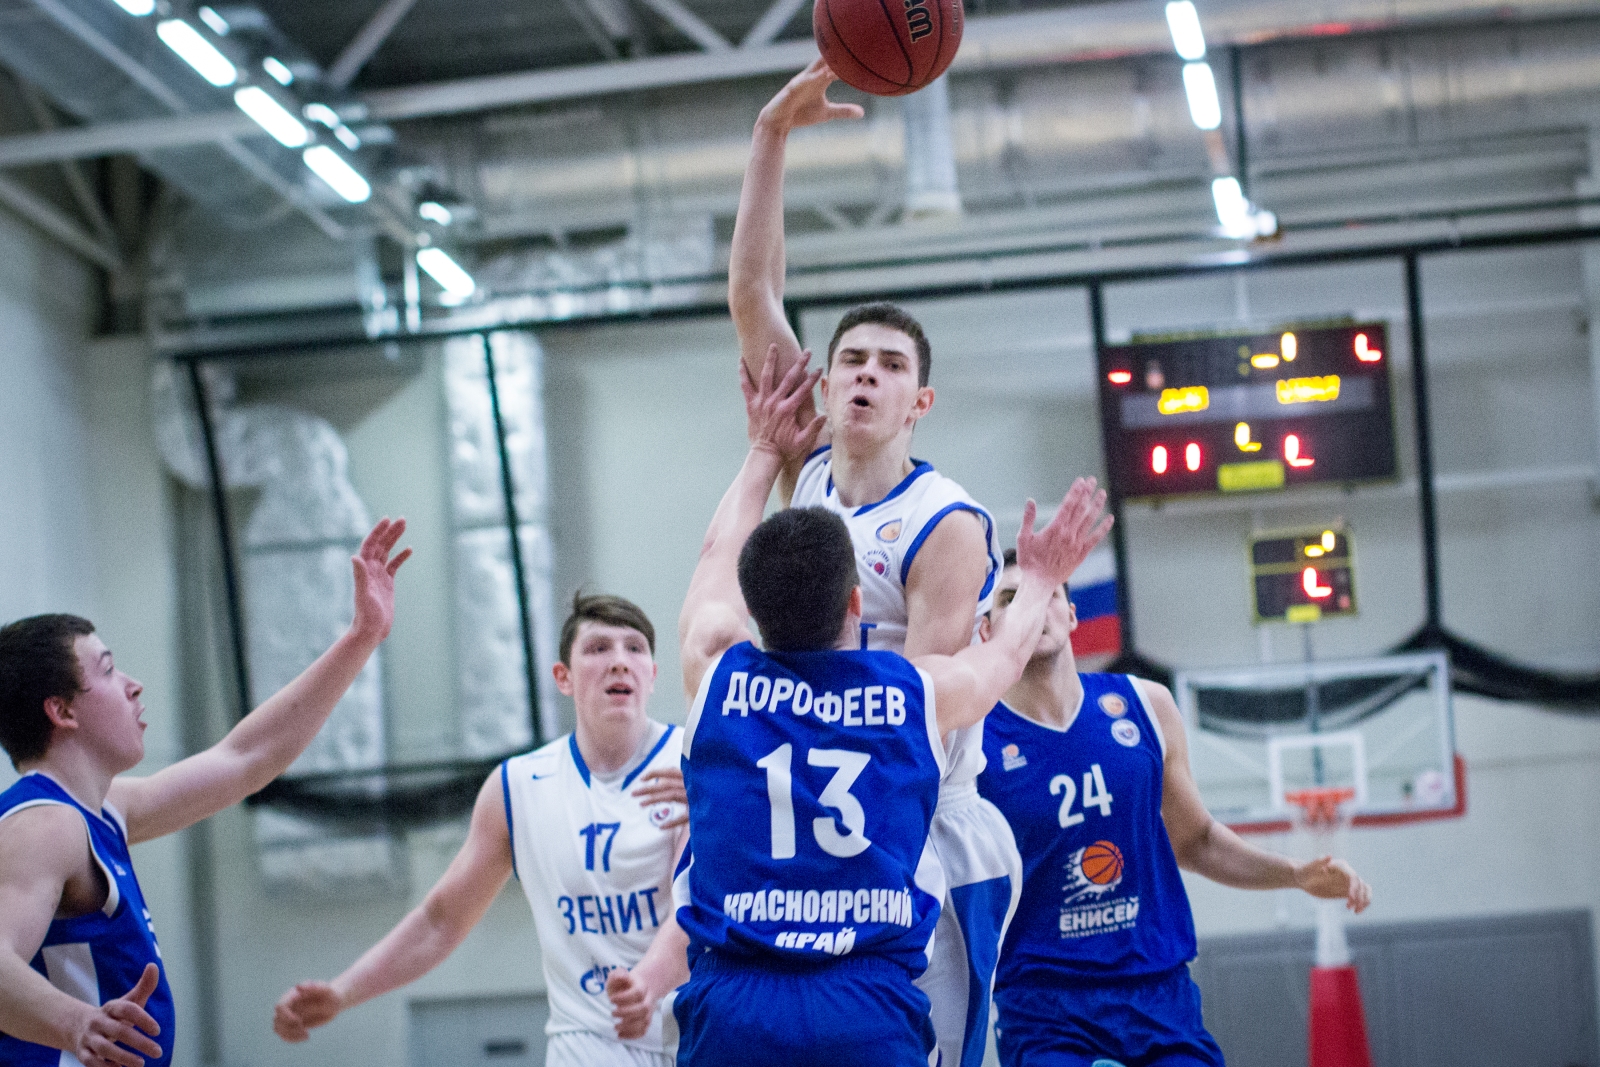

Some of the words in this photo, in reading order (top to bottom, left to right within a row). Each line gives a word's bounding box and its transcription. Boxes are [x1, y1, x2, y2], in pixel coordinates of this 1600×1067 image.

[722, 671, 906, 727] ДОРОФЕЕВ
[756, 742, 872, 859] 13
[1049, 763, 1113, 829] 24
[579, 821, 621, 873] 17
[557, 887, 660, 935] ЗЕНИТ
[723, 887, 913, 928] КРАСНОЯРСКИЙ
[1059, 896, 1140, 932] ЕНИСЕЙ
[774, 926, 857, 956] КРАЙ
